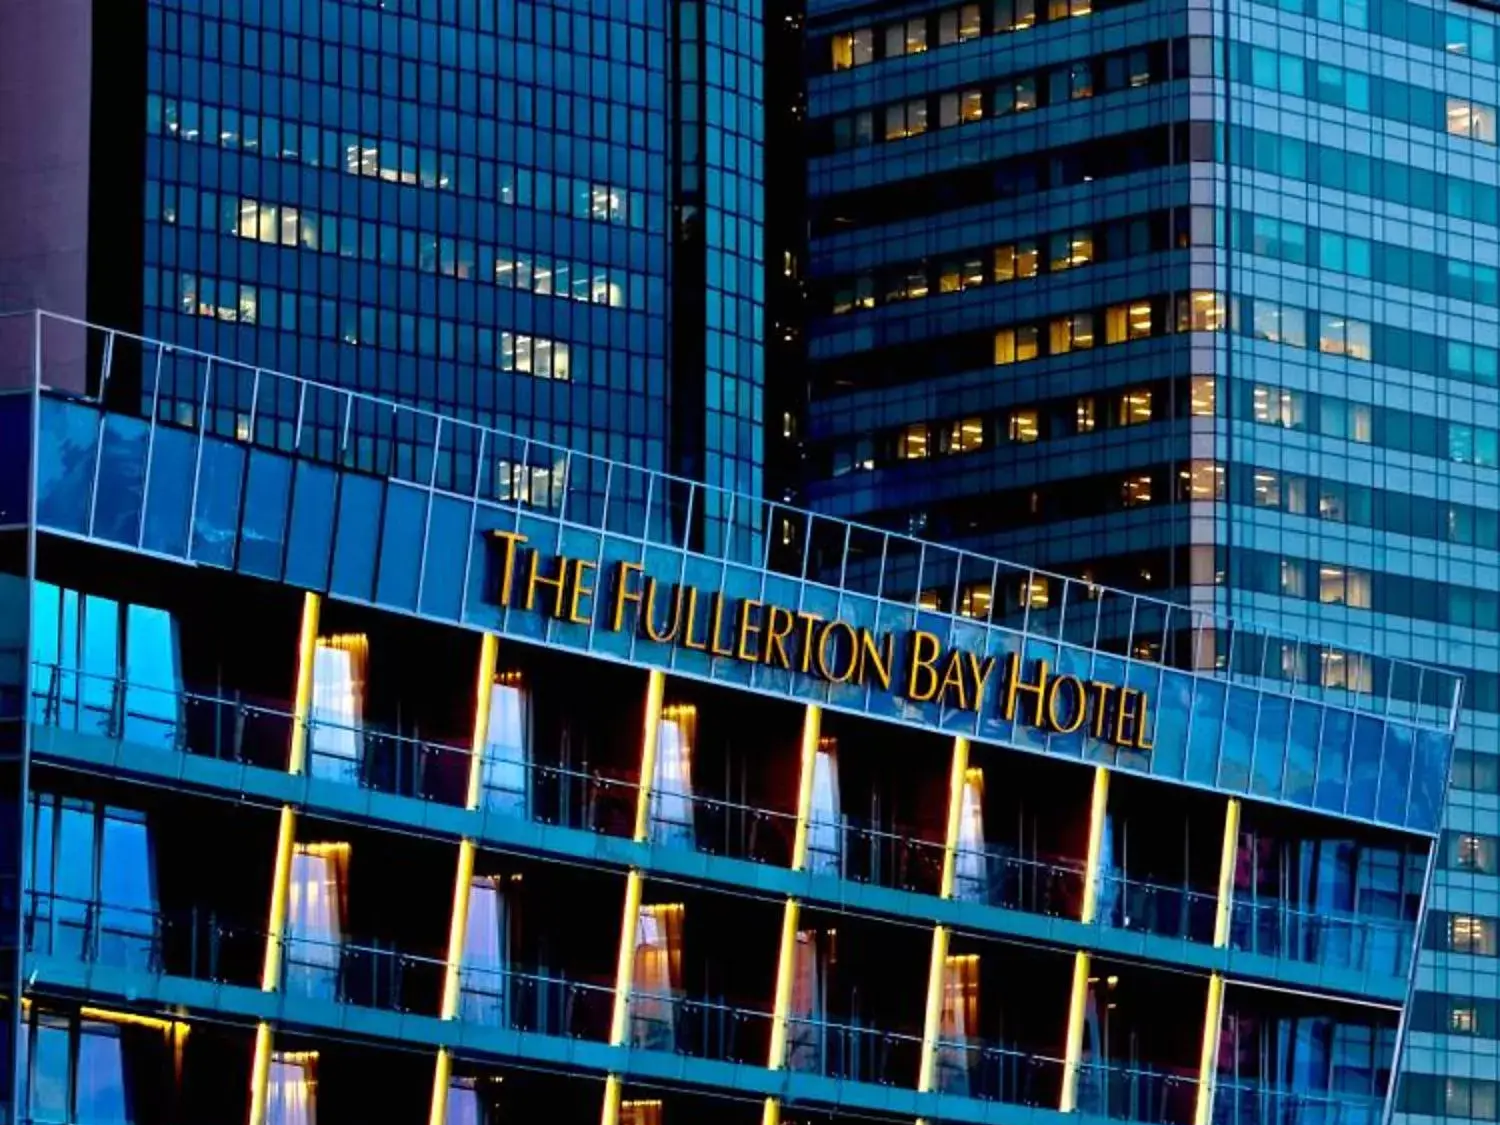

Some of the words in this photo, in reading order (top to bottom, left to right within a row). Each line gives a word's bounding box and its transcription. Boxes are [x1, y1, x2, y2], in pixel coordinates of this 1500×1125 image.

[487, 530, 598, 625] THE
[611, 559, 894, 693] FULLERTON
[907, 630, 994, 713] BAY
[1005, 653, 1154, 750] HOTEL
